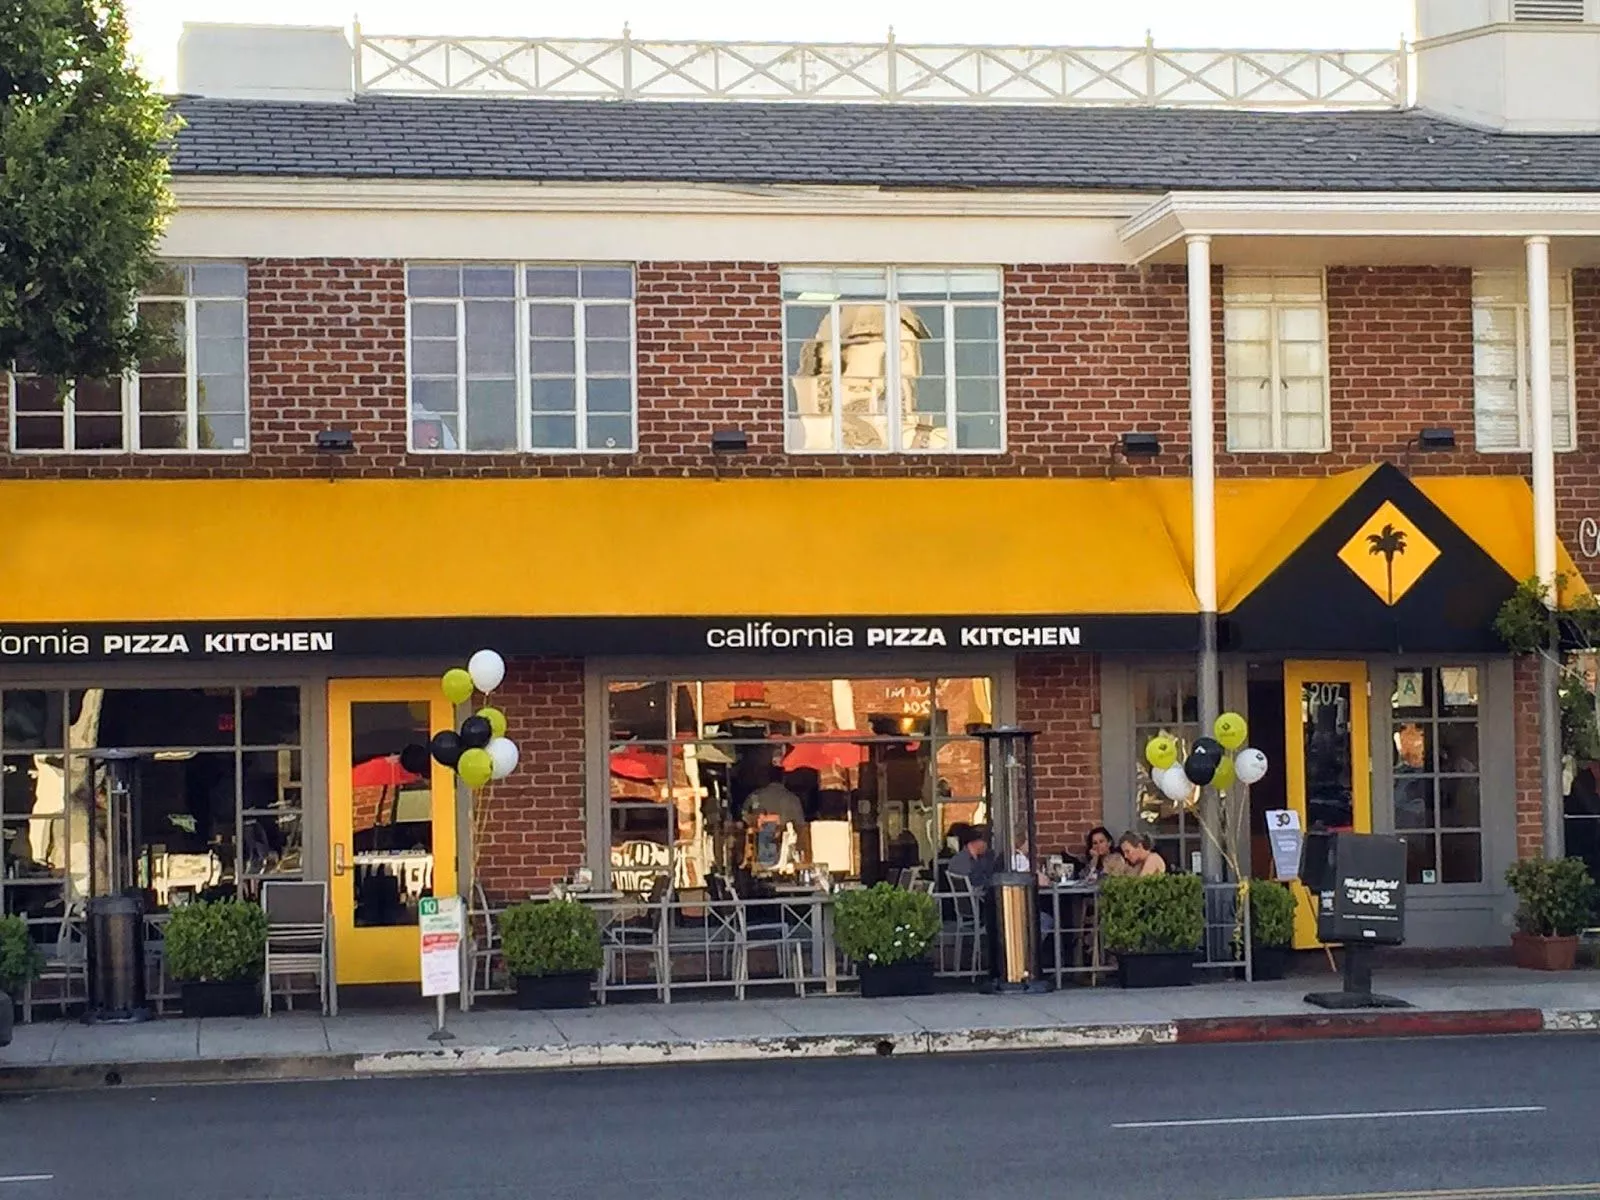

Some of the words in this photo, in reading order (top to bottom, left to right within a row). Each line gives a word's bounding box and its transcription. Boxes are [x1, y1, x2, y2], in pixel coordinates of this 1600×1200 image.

[1580, 517, 1600, 557] C
[0, 628, 90, 655] ornia
[104, 634, 189, 654] PIZZA
[205, 632, 334, 652] KITCHEN
[706, 622, 854, 648] california
[867, 627, 947, 646] PIZZA
[961, 627, 1081, 646] KITCHEN
[1310, 683, 1341, 705] 207
[1403, 679, 1416, 695] A
[423, 900, 436, 915] 10
[1352, 889, 1390, 905] JOBS
